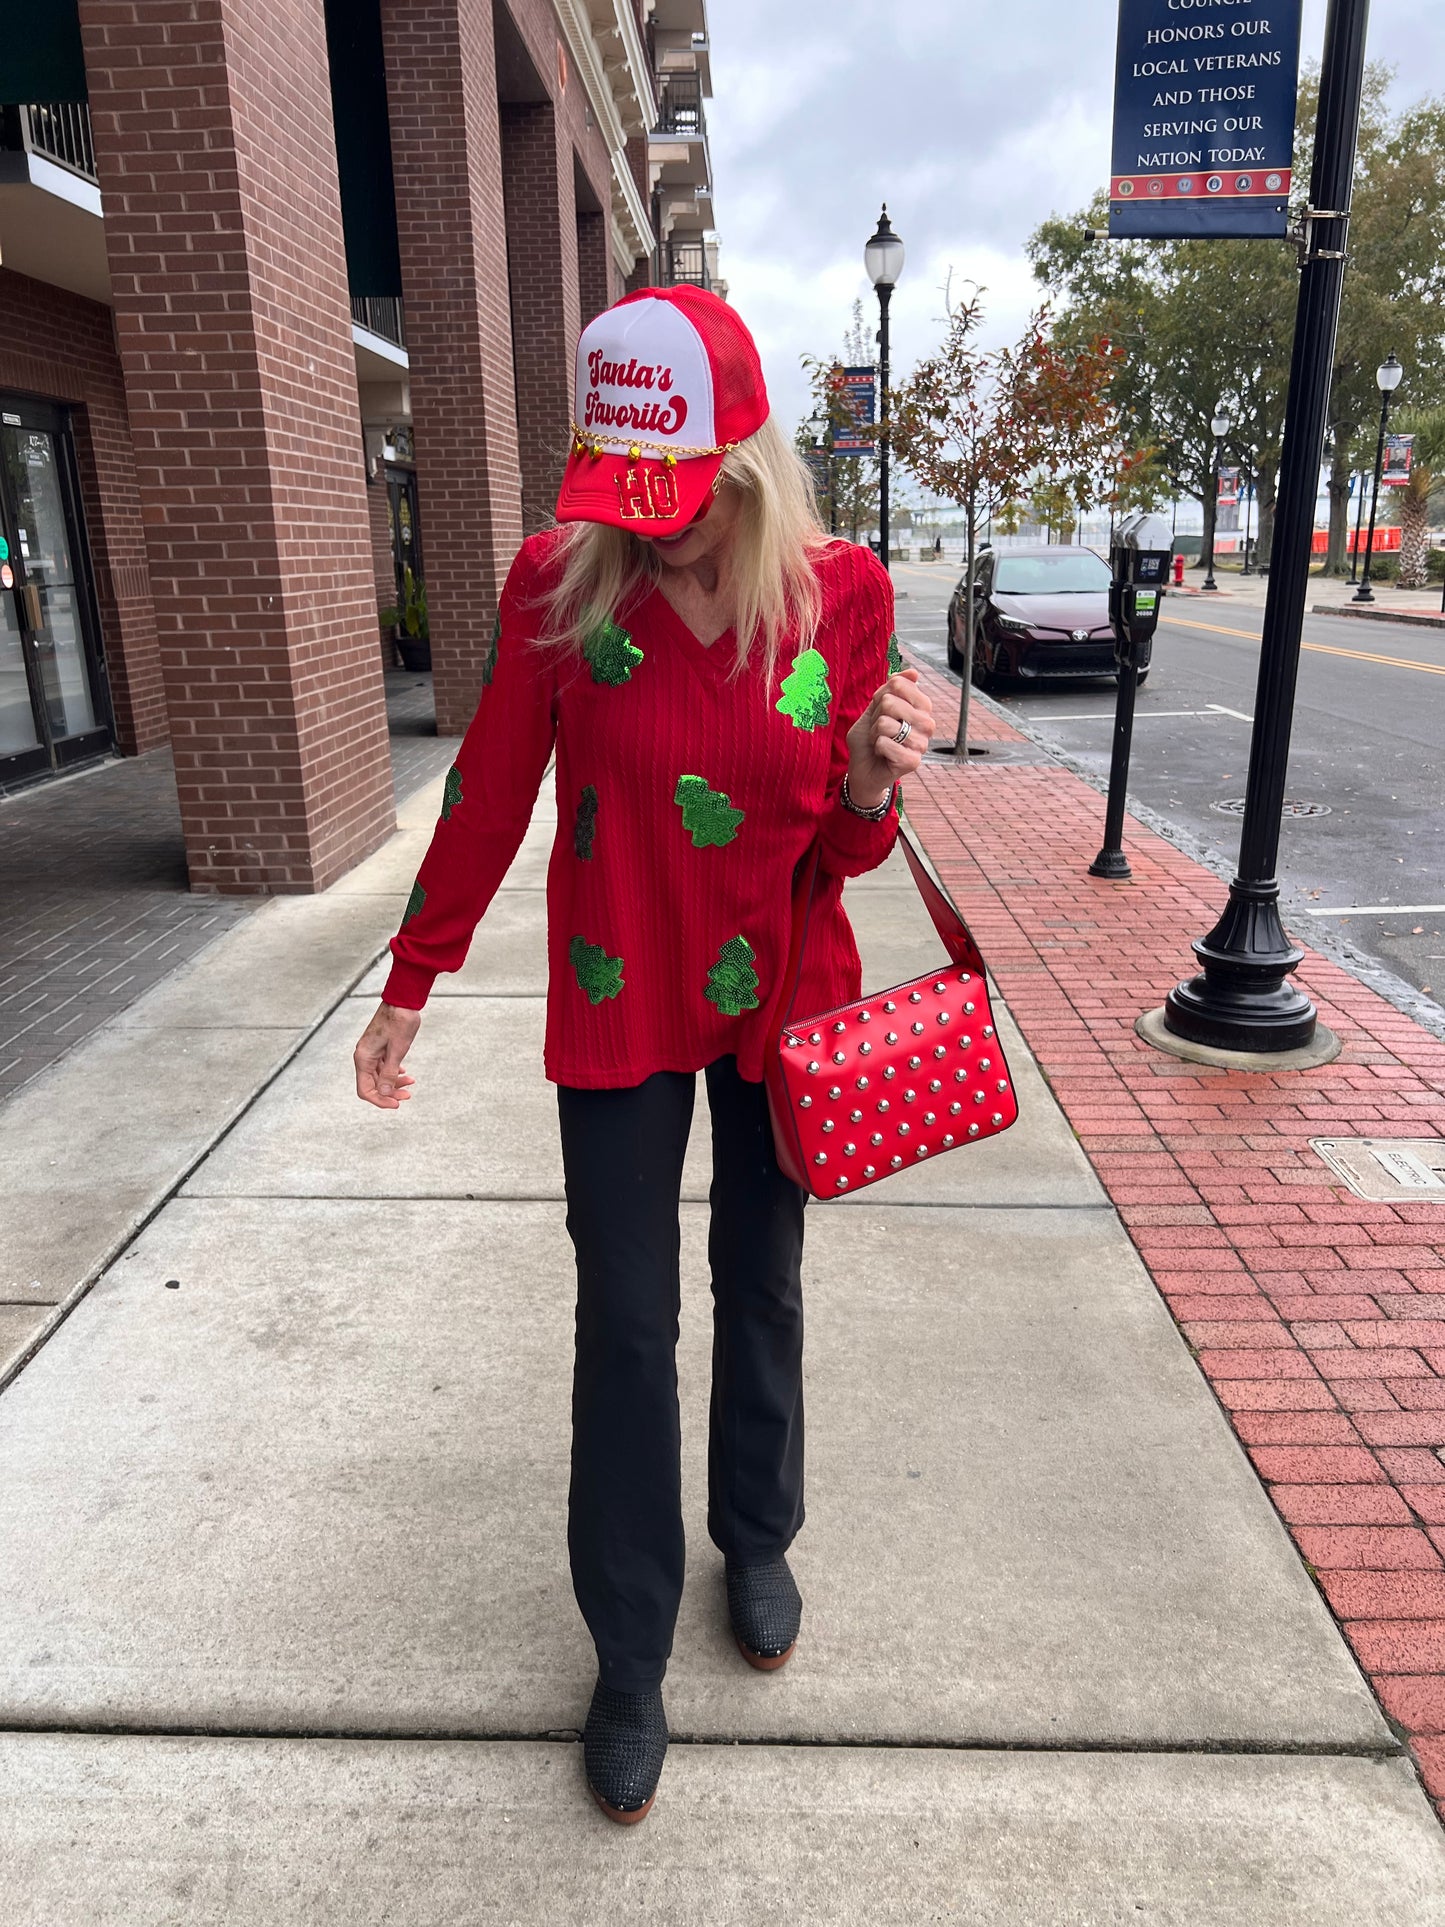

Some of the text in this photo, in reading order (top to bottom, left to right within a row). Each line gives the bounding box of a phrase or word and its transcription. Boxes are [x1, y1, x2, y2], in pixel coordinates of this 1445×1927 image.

[1167, 0, 1252, 10] COUN
[1147, 20, 1271, 44] HONORS OUR
[1133, 51, 1281, 77] LOCAL VETERANS
[1152, 85, 1255, 107] AND THOSE
[1143, 116, 1263, 138] SERVING OUR
[1137, 147, 1265, 167] NATION TODAY.
[588, 349, 673, 391] Santa's
[585, 391, 688, 435] Favorite
[613, 467, 680, 519] HO
[1388, 1153, 1427, 1185] ELECTRIC
